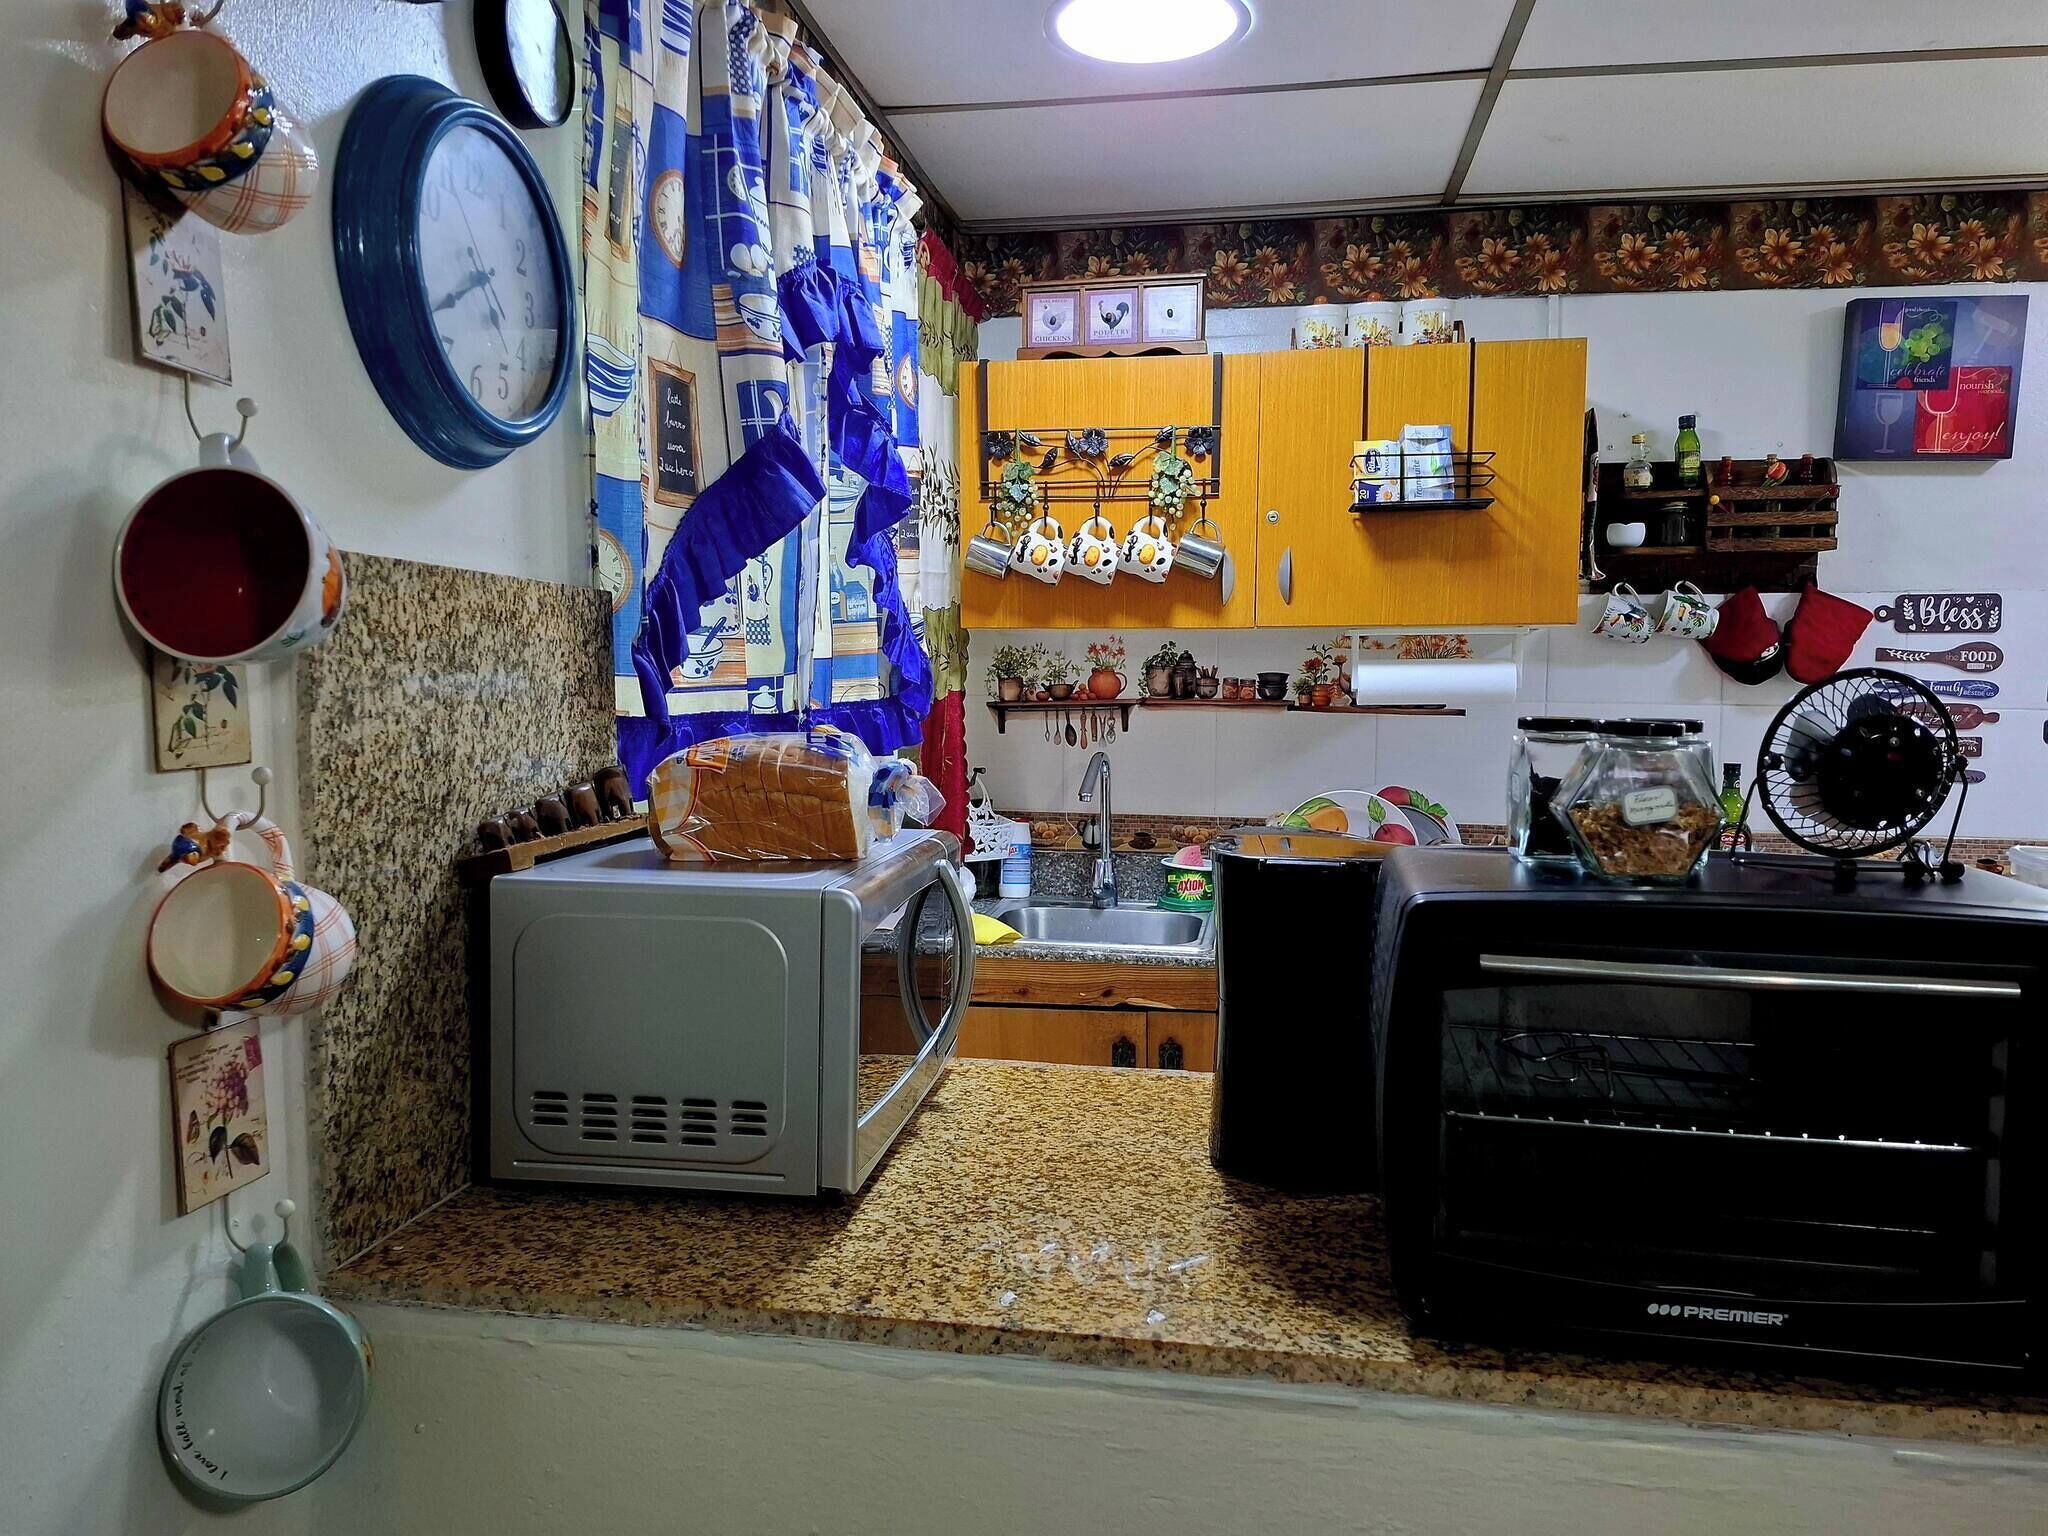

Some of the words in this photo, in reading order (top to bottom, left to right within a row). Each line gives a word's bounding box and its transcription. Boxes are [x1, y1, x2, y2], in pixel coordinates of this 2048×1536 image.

[464, 154, 485, 199] 12
[515, 239, 527, 278] 2
[524, 292, 535, 329] 3
[516, 336, 526, 372] 4
[1889, 362, 1945, 377] celebrate
[471, 364, 482, 401] 6
[498, 363, 509, 401] 5
[1960, 380, 1993, 390] nourish
[1942, 421, 2005, 453] enjoy!
[1360, 489, 1367, 500] 20
[1920, 596, 1985, 630] Bless
[1960, 650, 1997, 662] FOOD
[1178, 878, 1205, 893] AXION
[1683, 1305, 1784, 1326] PREMIER
[193, 1450, 219, 1473] love
